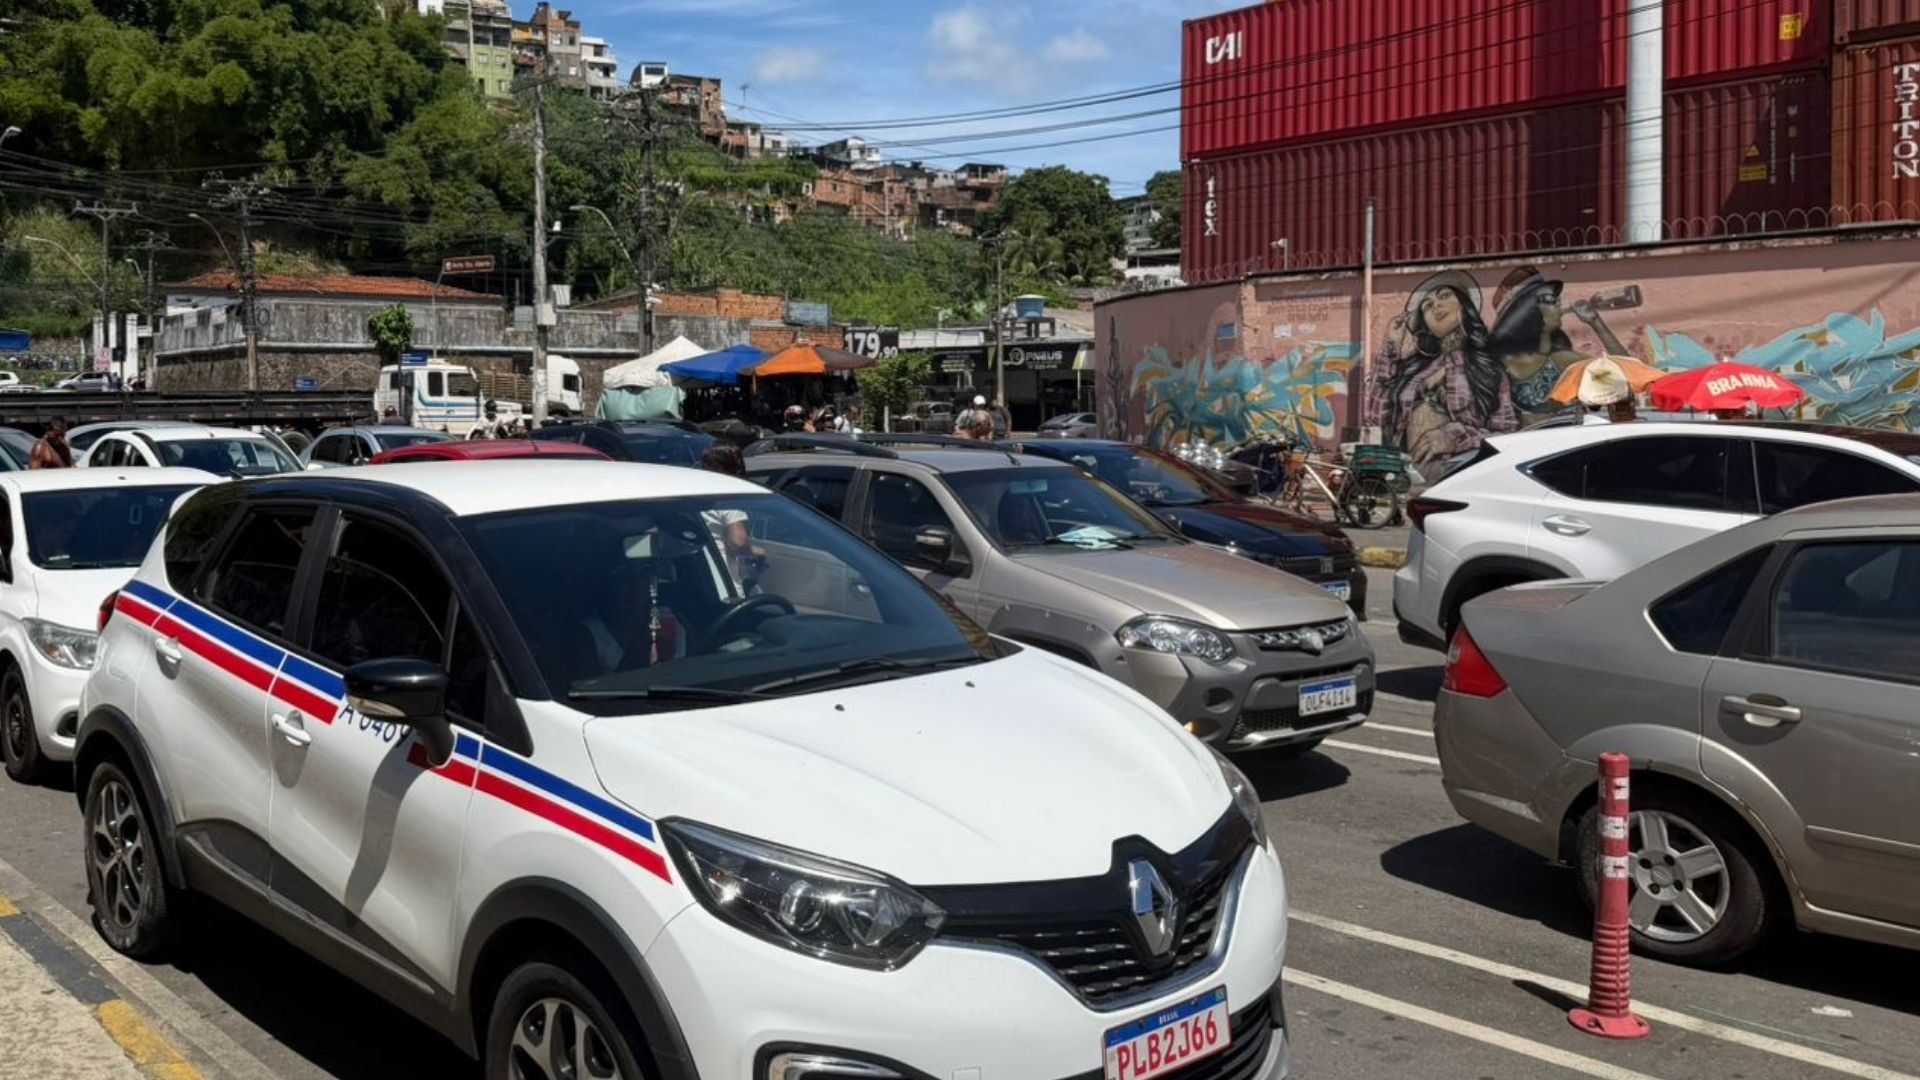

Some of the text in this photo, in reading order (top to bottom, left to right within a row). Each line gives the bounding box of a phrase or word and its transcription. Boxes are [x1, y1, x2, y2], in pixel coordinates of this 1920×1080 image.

[1206, 31, 1242, 64] CAI
[1892, 63, 1920, 179] TRITON
[1706, 372, 1779, 396] BRAHMA
[1116, 1009, 1218, 1080] PLB2J66
